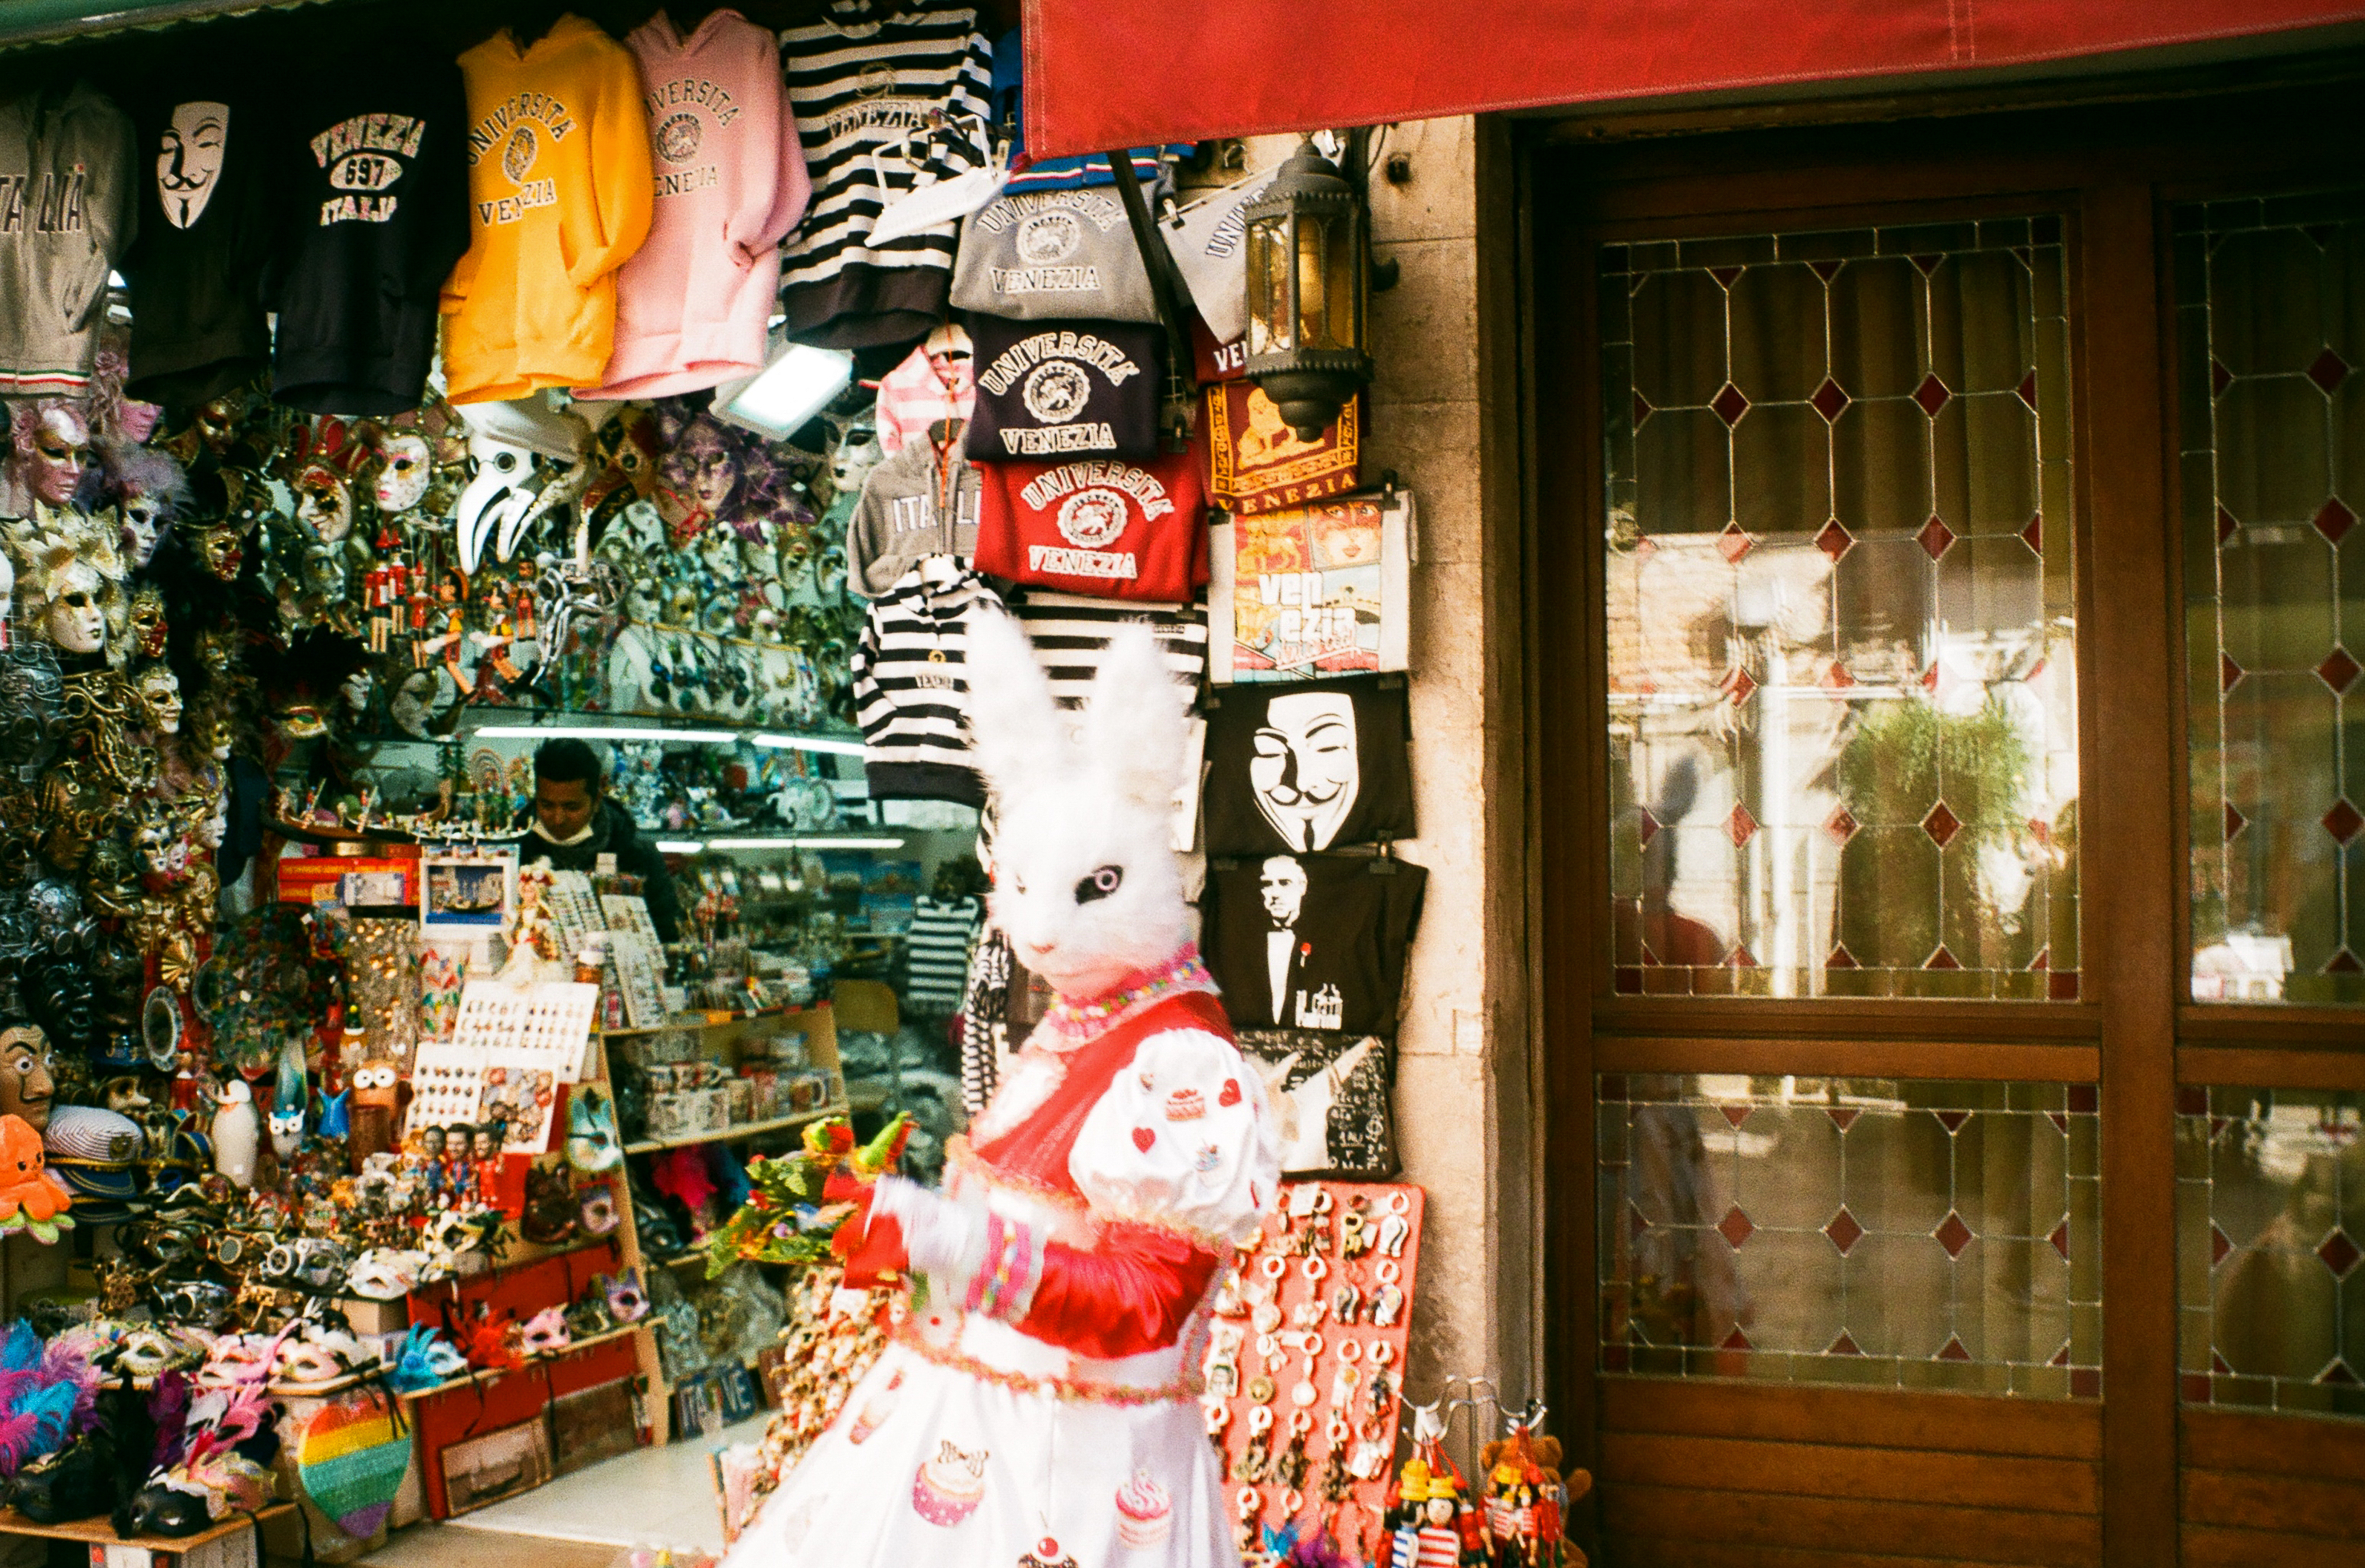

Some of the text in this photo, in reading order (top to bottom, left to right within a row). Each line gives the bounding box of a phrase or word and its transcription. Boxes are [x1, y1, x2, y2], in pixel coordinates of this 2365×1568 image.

[345, 158, 385, 186] 697
[990, 267, 1101, 294] VENEZIA
[978, 331, 1140, 396] UNIVERSITA
[1000, 423, 1116, 455] VENEZIA
[1020, 460, 1175, 522] UNIVERSITA
[1217, 473, 1356, 515] VENEZIA
[1028, 545, 1138, 579] VENEZIA
